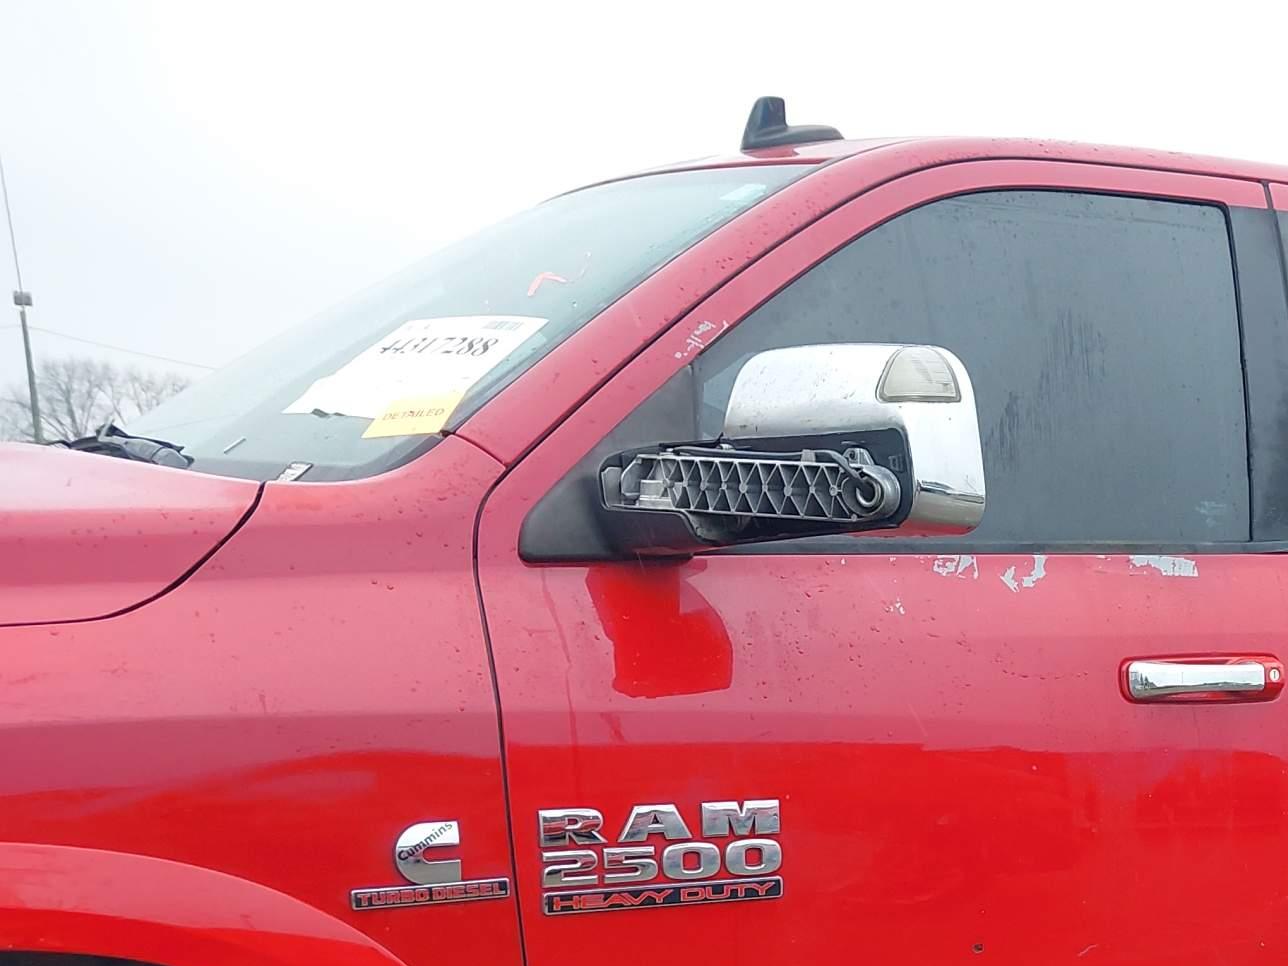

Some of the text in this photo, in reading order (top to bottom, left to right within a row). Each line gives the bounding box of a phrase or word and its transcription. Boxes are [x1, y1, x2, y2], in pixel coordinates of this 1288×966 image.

[379, 336, 499, 356] 44317288
[538, 799, 781, 847] RAM
[398, 822, 453, 861] Cummins
[542, 838, 783, 889] 2500
[356, 882, 506, 906] TURBO DIESEL
[553, 881, 776, 911] HEAVY DUTY
